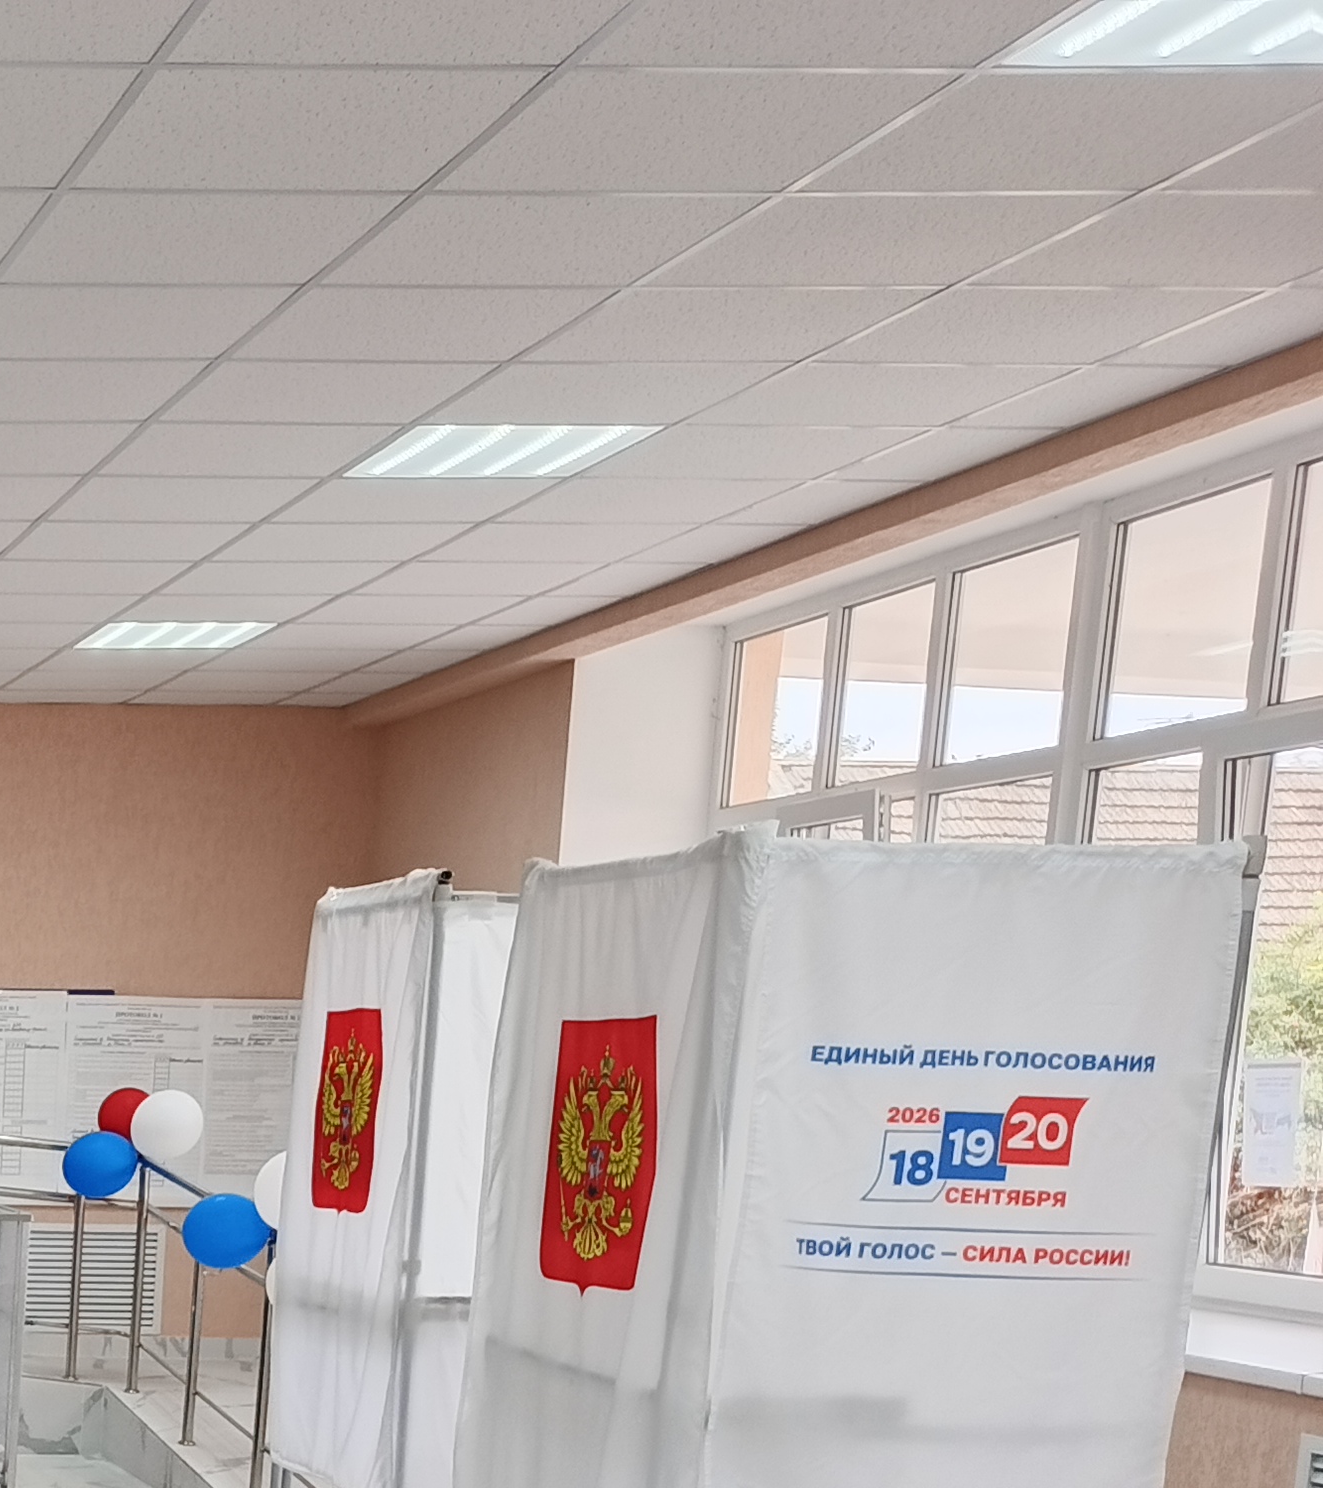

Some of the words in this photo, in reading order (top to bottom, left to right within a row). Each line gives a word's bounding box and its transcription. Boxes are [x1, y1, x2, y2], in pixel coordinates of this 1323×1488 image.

[810, 1044, 914, 1066] ЕДИНЫЙ
[919, 1048, 979, 1069] ДЕНЬ
[984, 1050, 1155, 1073] ГОЛОСОВАНИЯ
[886, 1106, 940, 1124] 2026
[888, 1149, 935, 1186] 18
[948, 1127, 995, 1168] 19
[1006, 1111, 1069, 1151] 20
[944, 1186, 1067, 1208] СЕНТЯБРЯ
[796, 1236, 852, 1258] ТВОЙ
[857, 1241, 935, 1261] ГОЛОС
[962, 1244, 1028, 1266] СИЛА
[1034, 1246, 1131, 1267] РОССИИ!
